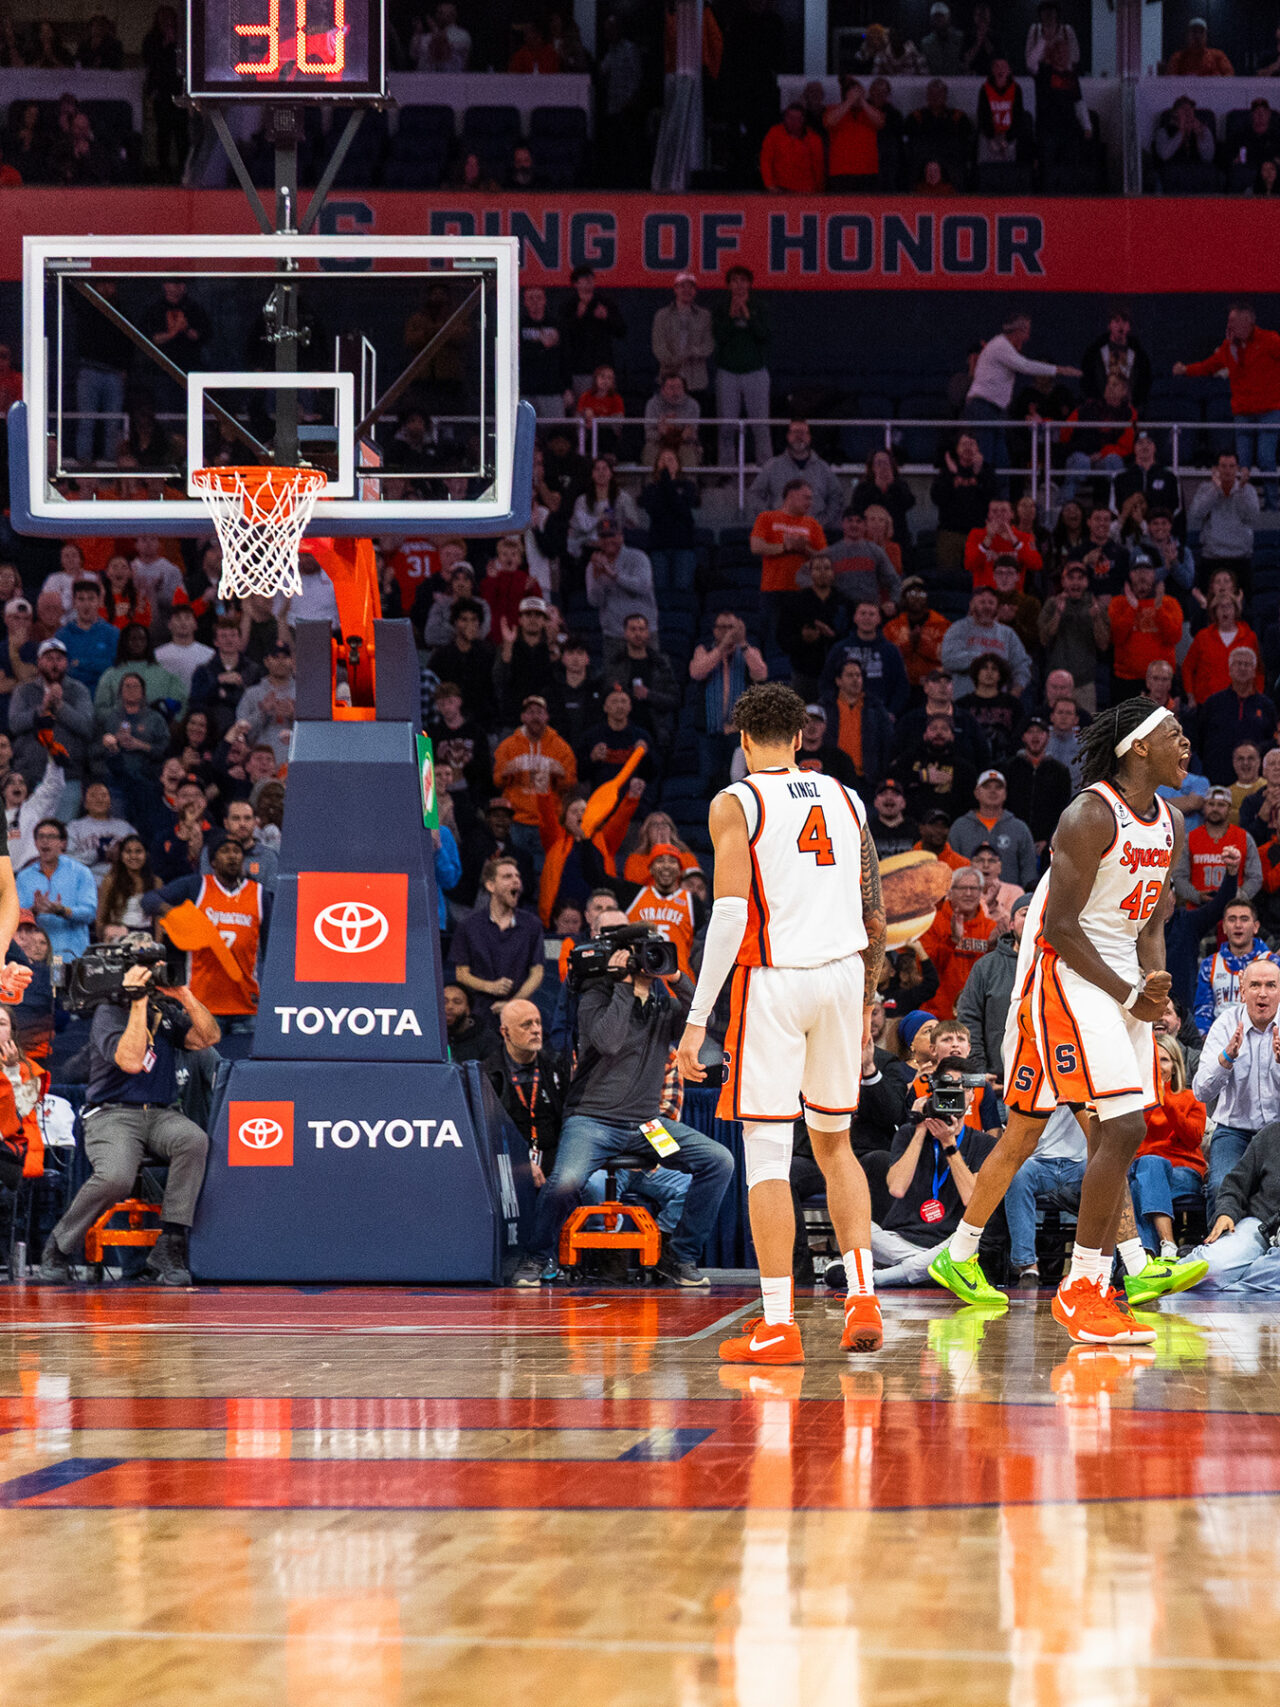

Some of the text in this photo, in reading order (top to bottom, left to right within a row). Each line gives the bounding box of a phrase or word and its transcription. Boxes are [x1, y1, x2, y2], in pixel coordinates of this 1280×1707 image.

[233, 0, 343, 75] 30
[643, 211, 746, 274] OF
[767, 212, 1046, 276] HONOR
[406, 555, 431, 578] 31
[786, 781, 821, 799] KINGZ
[797, 805, 836, 867] 4
[1119, 840, 1172, 875] Syracus
[1119, 880, 1164, 921] 42
[274, 1006, 423, 1036] TOYOTA
[1055, 1042, 1077, 1075] S
[1014, 1064, 1036, 1093] S
[307, 1120, 463, 1149] TOYOTA
